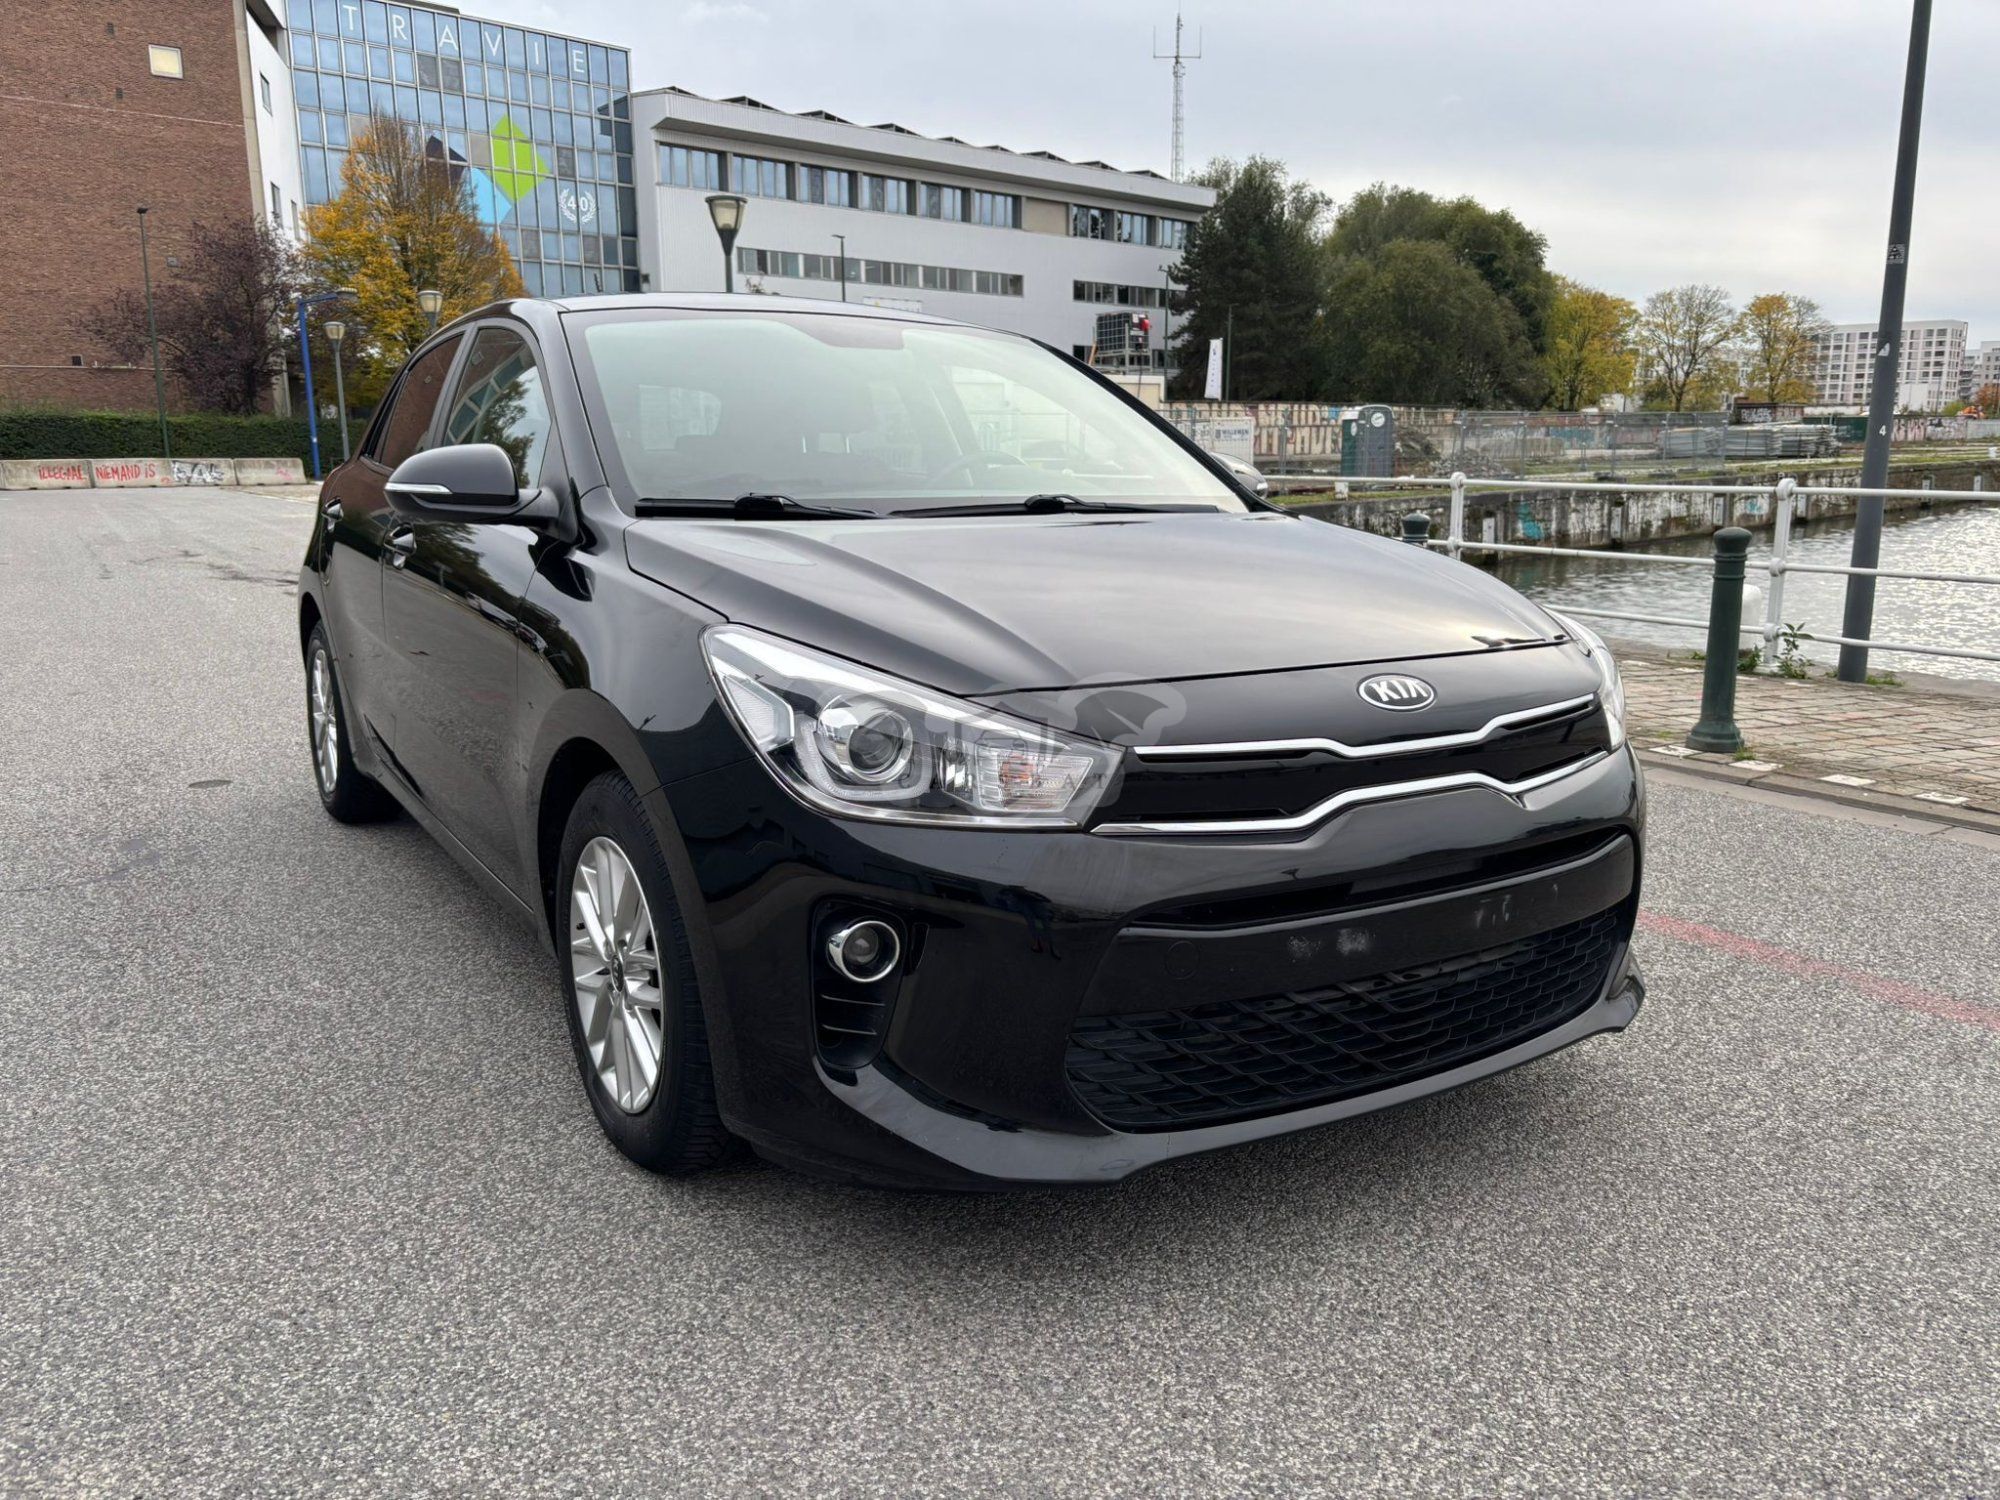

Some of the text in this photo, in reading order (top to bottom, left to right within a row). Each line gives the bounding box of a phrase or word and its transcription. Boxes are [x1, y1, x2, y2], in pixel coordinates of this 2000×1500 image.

[342, 5, 585, 74] TRAVIE
[567, 195, 589, 211] 40
[1879, 424, 1886, 436] 4
[1370, 678, 1429, 702] KIA
